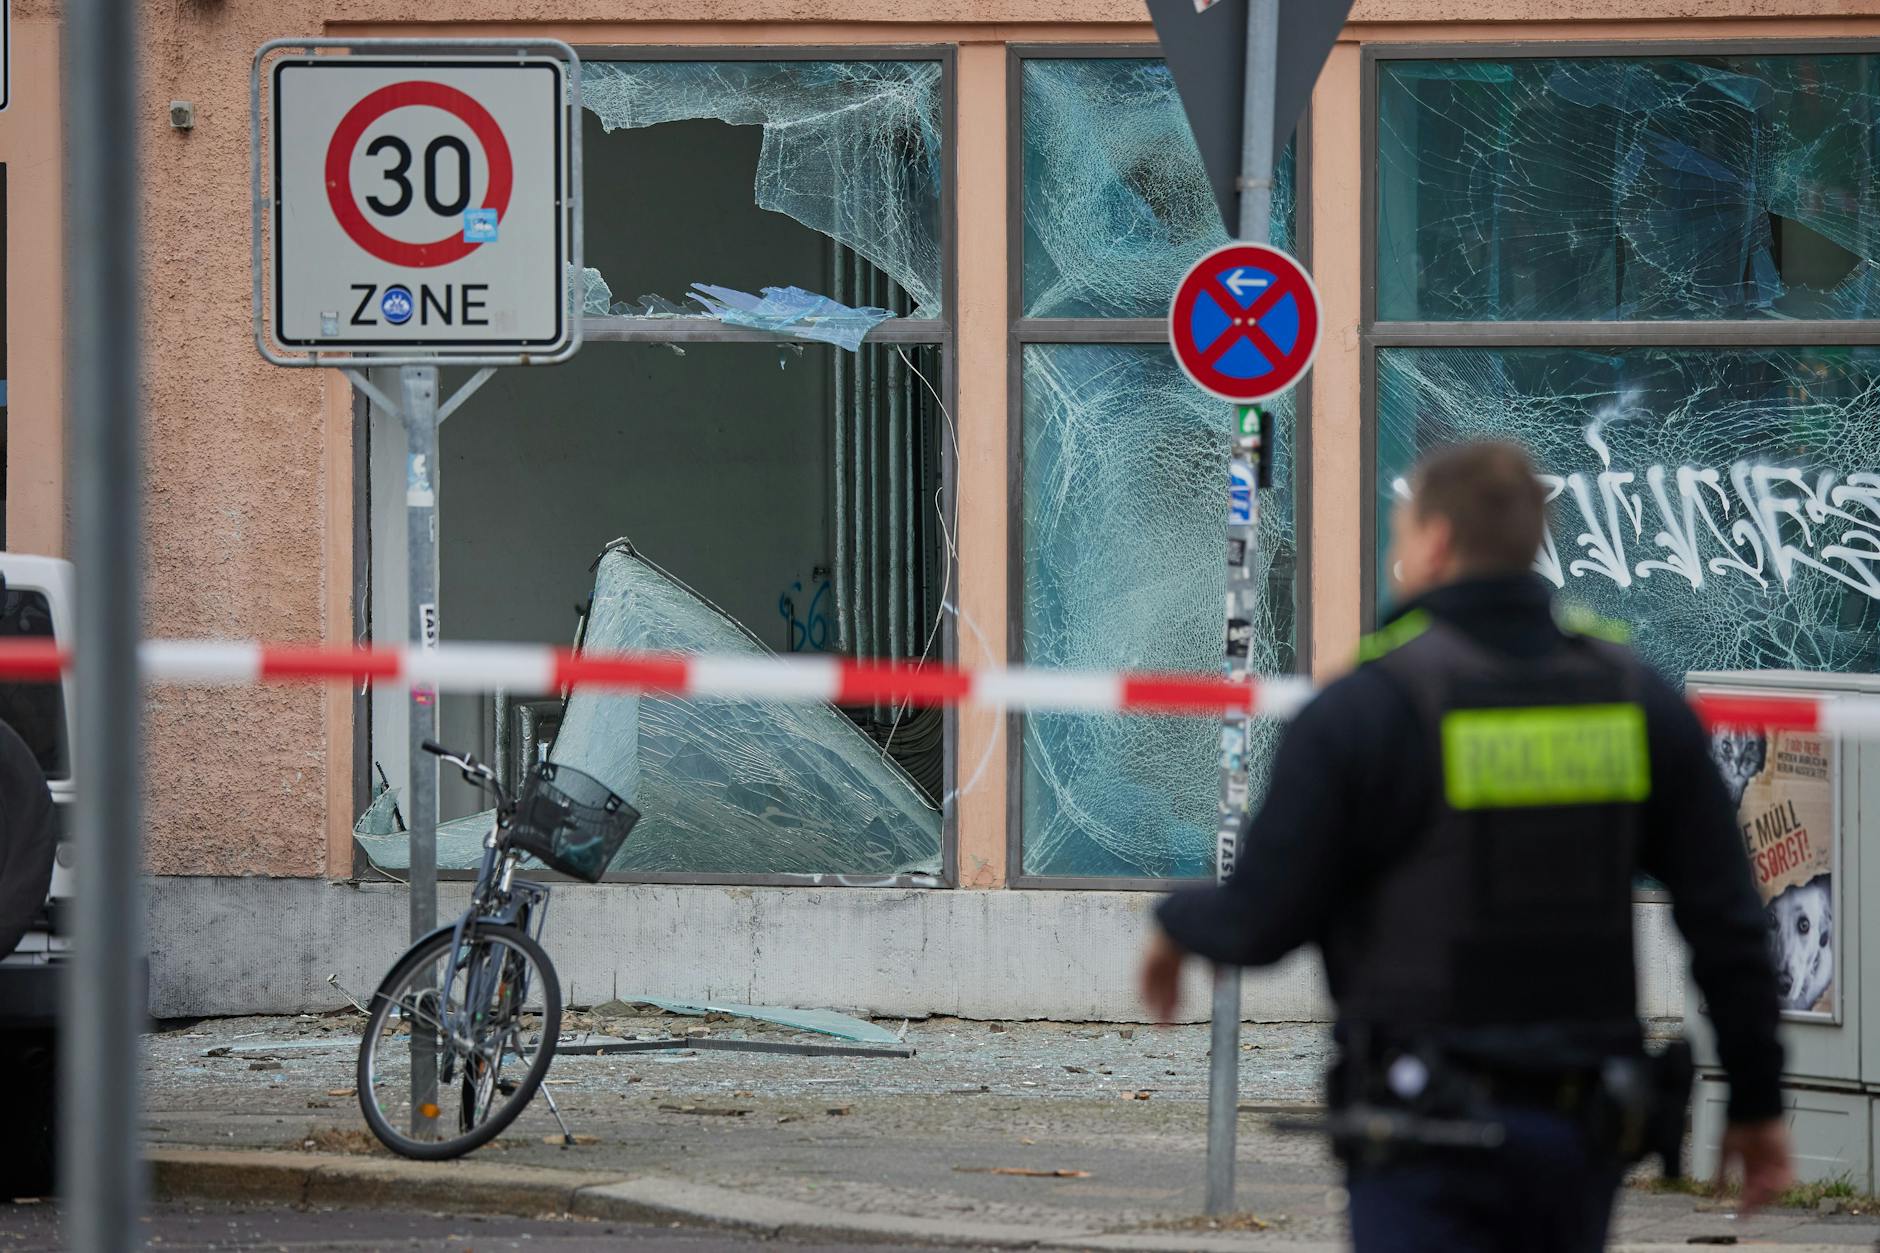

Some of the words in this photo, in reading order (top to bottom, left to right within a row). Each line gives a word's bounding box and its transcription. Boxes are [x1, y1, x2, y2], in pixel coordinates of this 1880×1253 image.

[365, 135, 471, 217] 30
[350, 284, 489, 326] ZONE
[1755, 800, 1801, 847] MÜLL
